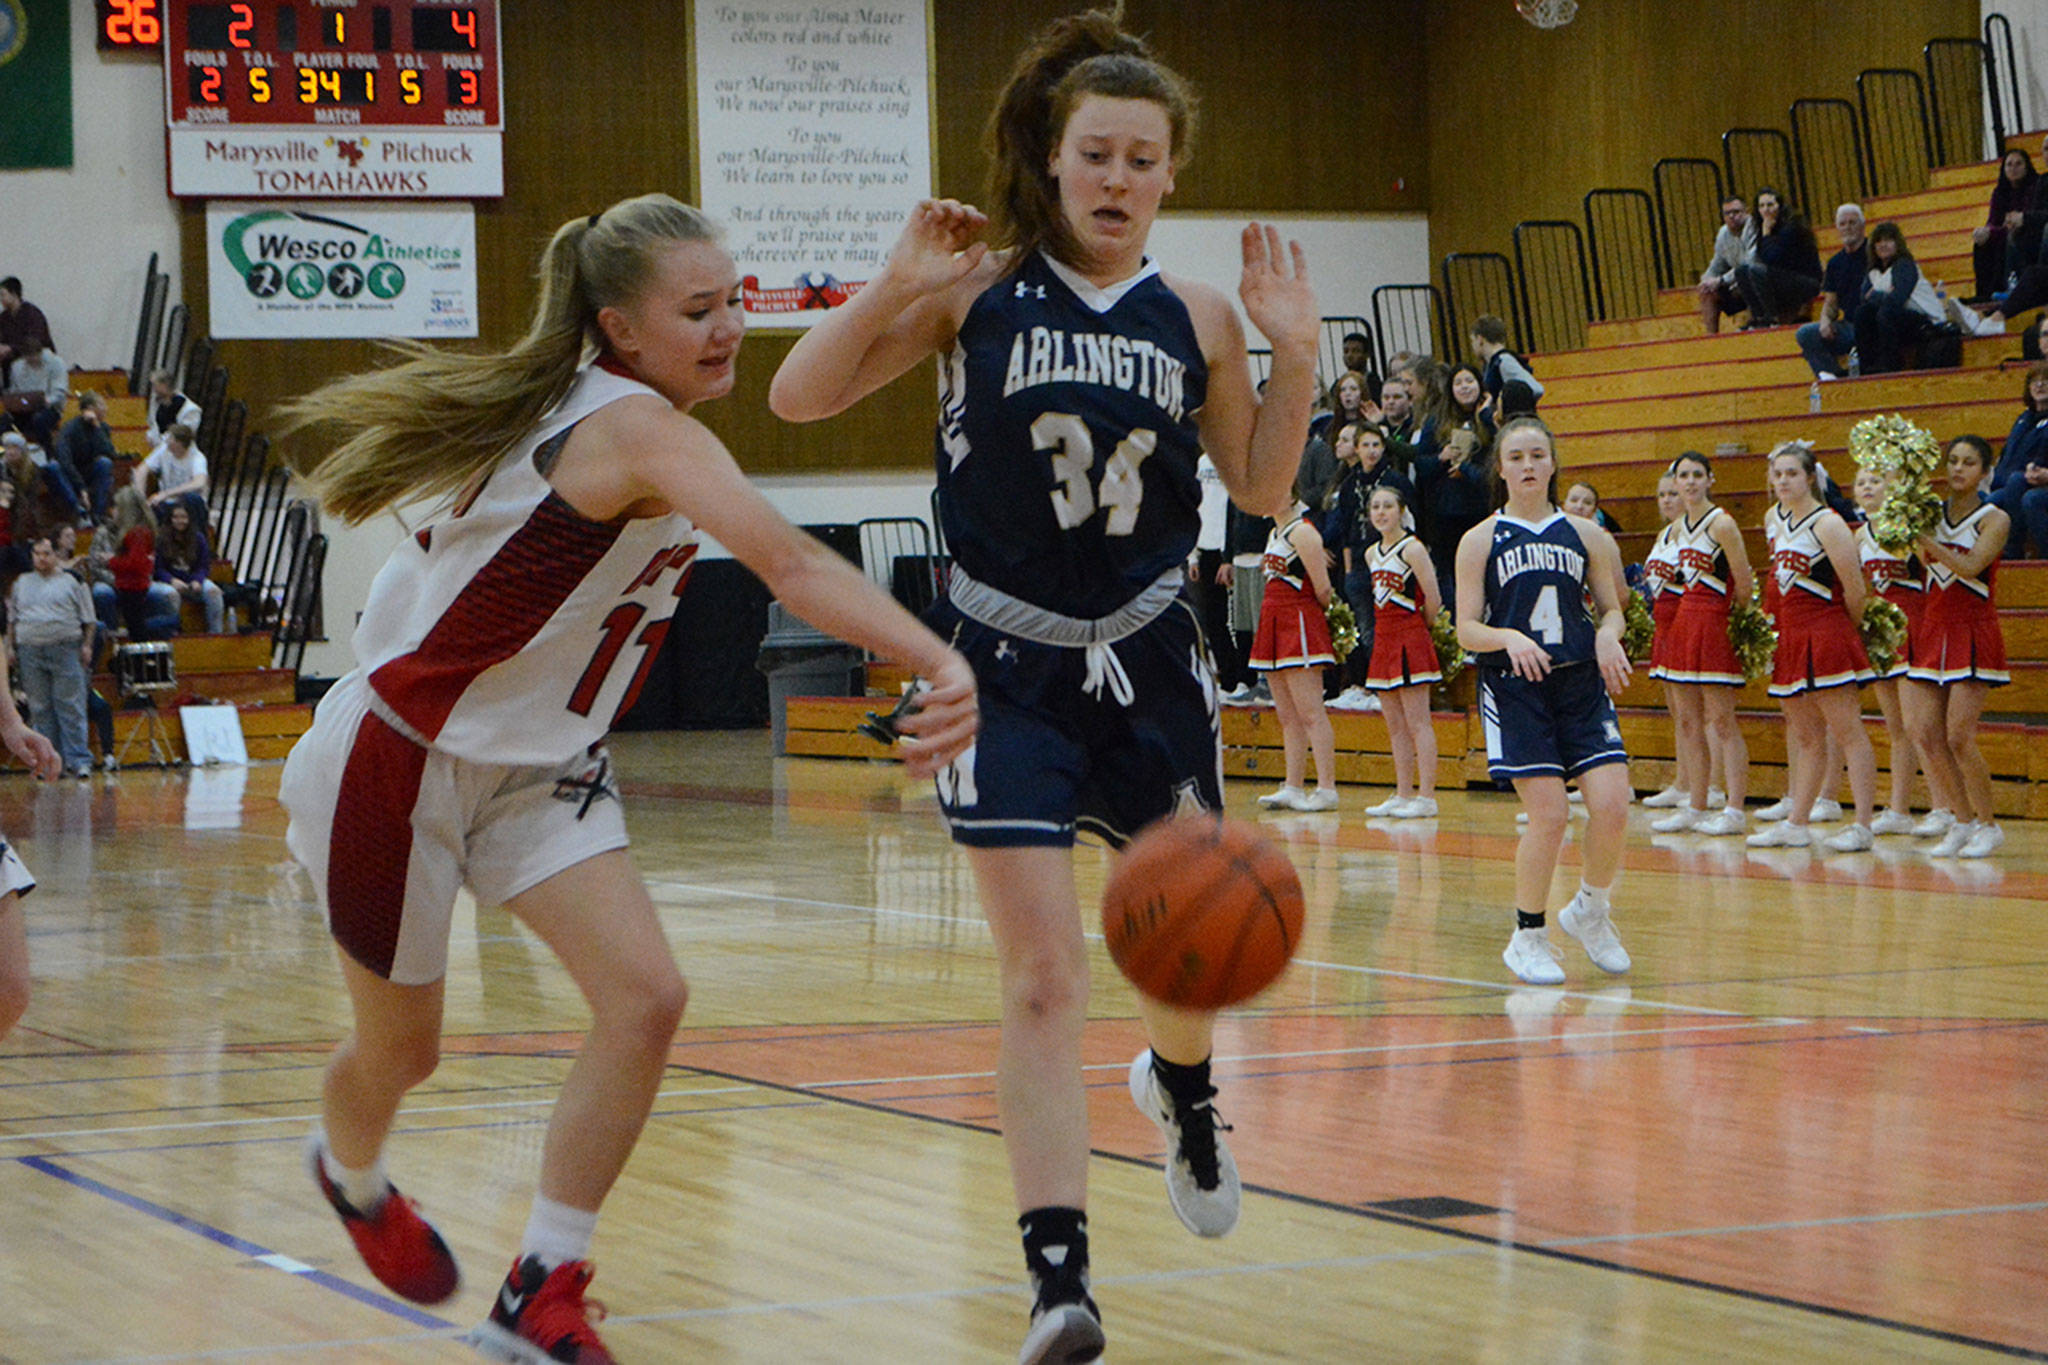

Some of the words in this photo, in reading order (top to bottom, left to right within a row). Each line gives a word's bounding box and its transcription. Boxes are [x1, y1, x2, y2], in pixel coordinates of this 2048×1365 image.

[105, 0, 161, 44] 26
[228, 3, 254, 48] 2
[335, 11, 345, 44] 1
[451, 10, 477, 49] 4
[715, 6, 737, 22] To
[742, 11, 769, 28] you
[775, 11, 801, 22] our
[806, 6, 849, 23] Alma
[855, 7, 904, 23] Mater
[731, 27, 776, 43] colors
[783, 28, 806, 44] red
[811, 28, 842, 44] and
[847, 26, 892, 44] white
[183, 51, 228, 67] FOULS
[293, 52, 344, 68] PLAYER
[347, 53, 380, 69] FOUL
[442, 54, 484, 69] FOULS
[785, 55, 808, 71] To
[812, 60, 840, 77] you
[200, 66, 222, 102] 2
[249, 67, 271, 103] 5
[299, 68, 342, 104] 34
[365, 71, 375, 102] 1
[400, 69, 422, 104] 5
[460, 70, 478, 104] 3
[714, 79, 742, 91] our
[186, 107, 230, 123] SCORE
[314, 109, 361, 124] MATCH
[443, 109, 486, 125] SCORE
[716, 94, 744, 112] We
[787, 100, 814, 112] our
[818, 98, 873, 119] praises
[878, 97, 911, 119] sing
[787, 125, 810, 142] To
[813, 131, 841, 148] you
[205, 139, 319, 165] Marysville
[382, 140, 475, 163] Pilchuck
[717, 152, 743, 163] our
[253, 169, 429, 192] TOMAHAWKS
[722, 165, 750, 183] We
[755, 167, 795, 183] learn
[801, 169, 818, 184] to
[822, 166, 853, 184] love
[858, 172, 886, 190] you
[891, 172, 909, 184] so
[729, 205, 764, 222] And
[769, 204, 831, 228] through
[836, 204, 861, 222] the
[864, 210, 905, 228] years
[258, 233, 357, 260] Wesco
[361, 233, 462, 261] Athletics
[798, 230, 845, 249] praise
[850, 231, 879, 248] you
[813, 249, 838, 262] we
[844, 249, 880, 268] may
[1003, 326, 1187, 424] ARLINGTON
[1030, 412, 1157, 536] 34
[1496, 542, 1586, 588] ARLINGTON
[1529, 584, 1564, 645] 4
